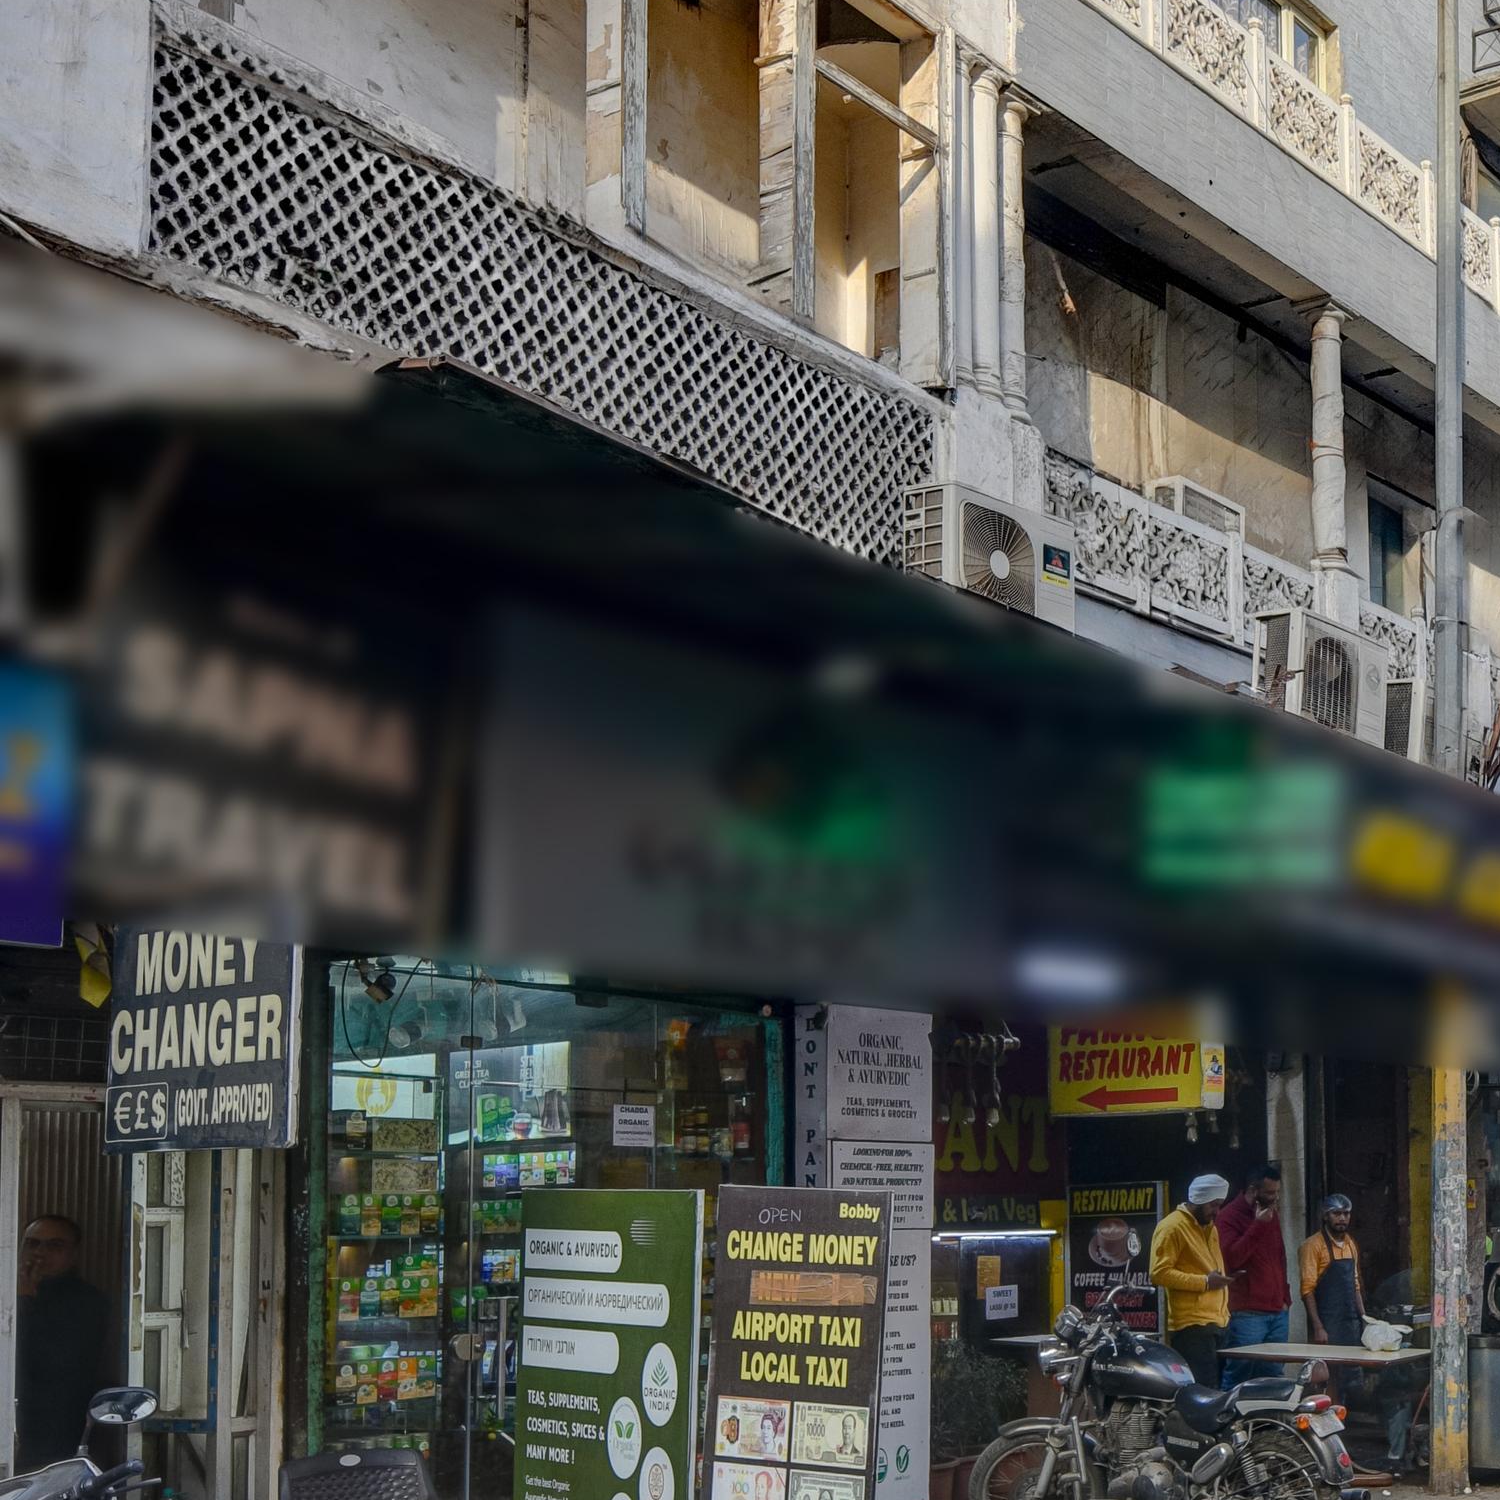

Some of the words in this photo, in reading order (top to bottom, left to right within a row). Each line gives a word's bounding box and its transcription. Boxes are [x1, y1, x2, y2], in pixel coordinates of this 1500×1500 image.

[135, 930, 258, 997] MONEY
[111, 994, 283, 1075] CHANGER
[858, 1032, 904, 1051] ORGANIC,
[837, 1050, 881, 1067] NATURAL
[1059, 1043, 1196, 1083] RESTAURANT
[847, 1069, 856, 1083] &
[857, 1070, 911, 1087] AYURVEDIC
[174, 1088, 209, 1136] (GOVT.
[211, 1083, 273, 1130] APPROVED)
[841, 1107, 879, 1118] COSMETICS
[887, 1109, 918, 1119] GROCERY
[866, 1098, 913, 1110] SUPPLEMENTS,
[1073, 1187, 1154, 1213] RESTAURANT
[759, 1207, 801, 1225] OPEN
[839, 1202, 881, 1222] Bobby
[943, 1197, 957, 1223] &
[1002, 1196, 1037, 1225] Veg
[529, 1240, 564, 1256] ORGANIC
[566, 1241, 572, 1256] &
[574, 1241, 619, 1258] AYURVEDIC
[727, 1230, 804, 1263] CHANGE
[808, 1234, 878, 1266] MONEY
[900, 1254, 917, 1267] US?
[1074, 1272, 1106, 1287] COFFEE
[528, 1288, 586, 1307] ОРГАНИЧЕСКИЙ
[587, 1292, 594, 1306] И
[732, 1310, 815, 1344] AIRPORT
[818, 1316, 862, 1348] TAXI
[740, 1351, 801, 1385] LOCAL
[805, 1355, 848, 1388] TAXI
[527, 1389, 547, 1408] TEAS,
[548, 1392, 601, 1414] SUPPLEMENTS,
[644, 1387, 676, 1400] ORGANIC
[650, 1401, 671, 1411] INDIA
[526, 1416, 570, 1439] COSMETICS,
[571, 1424, 597, 1440] SPICES
[598, 1426, 605, 1441] &
[526, 1443, 547, 1461] MANY
[548, 1447, 570, 1464] MORE
